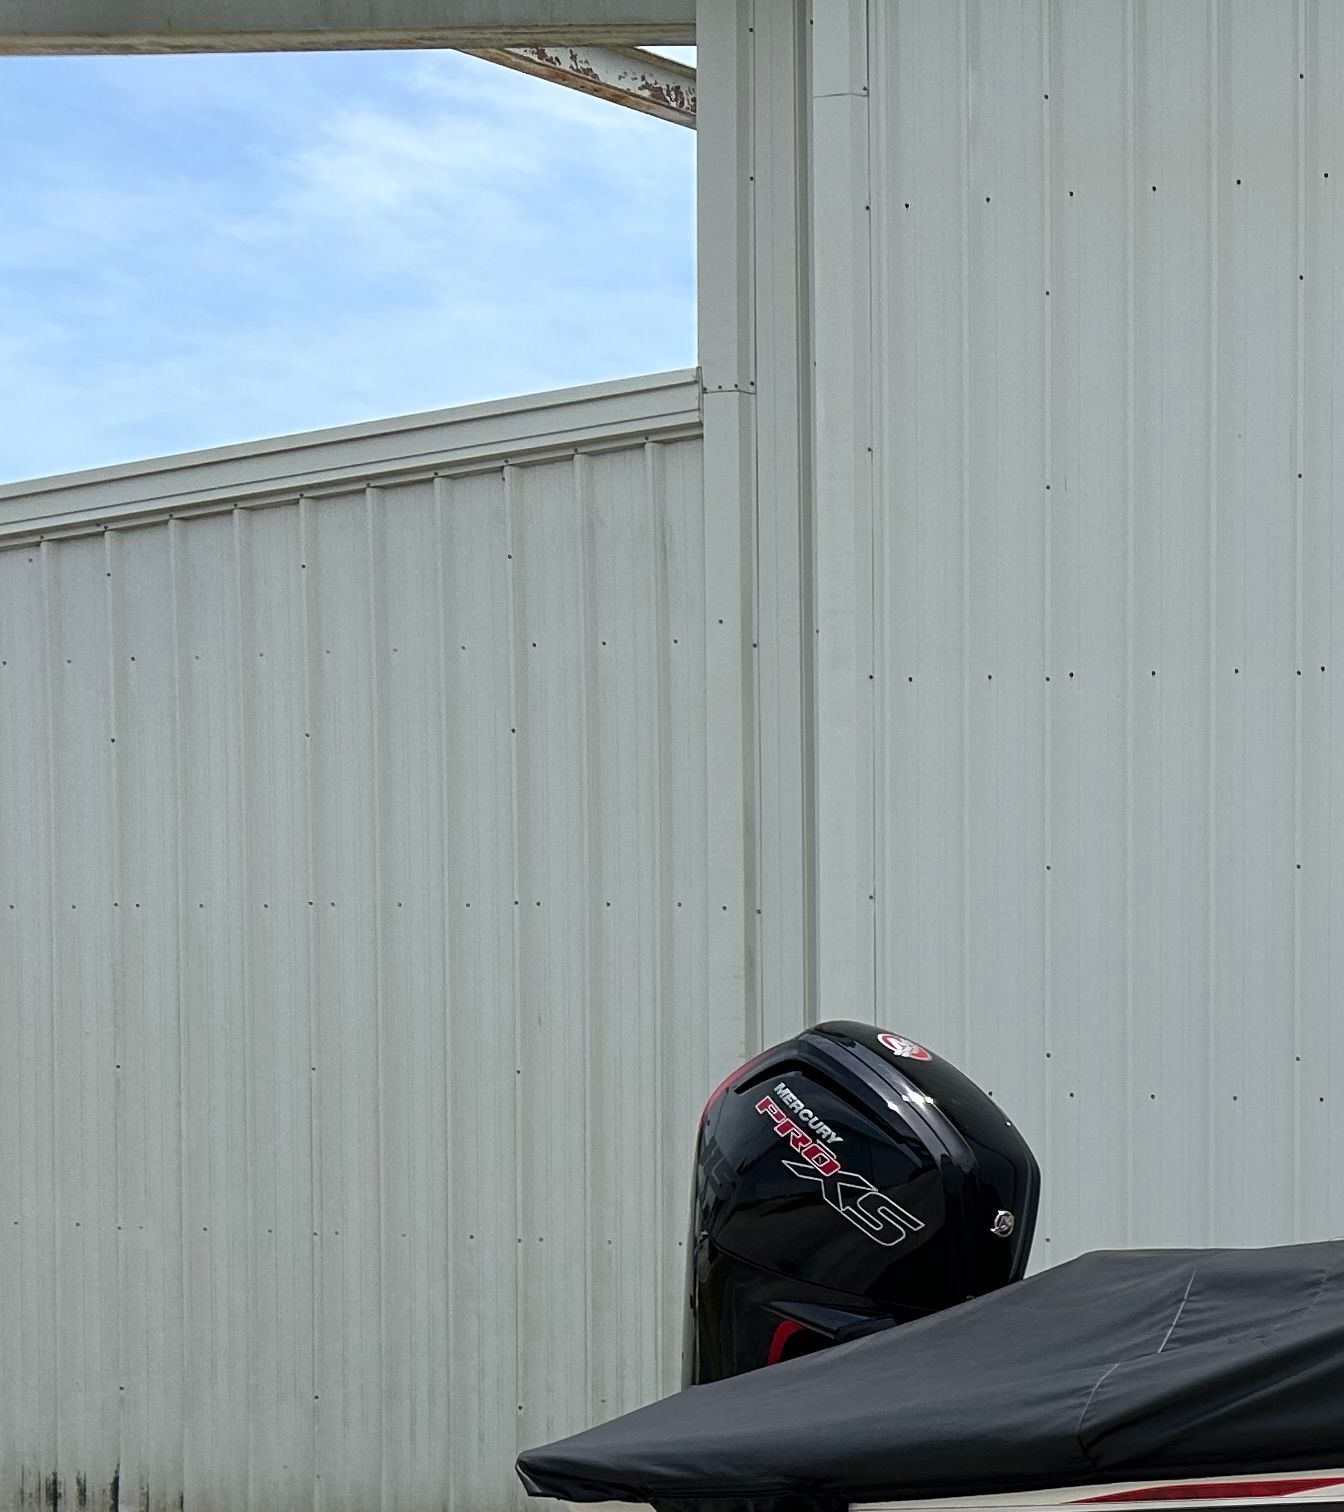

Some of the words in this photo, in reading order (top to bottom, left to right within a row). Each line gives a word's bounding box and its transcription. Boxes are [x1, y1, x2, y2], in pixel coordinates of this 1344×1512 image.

[754, 1095, 842, 1177] PRO
[773, 1082, 843, 1144] MERCURY
[780, 1158, 926, 1247] XS
